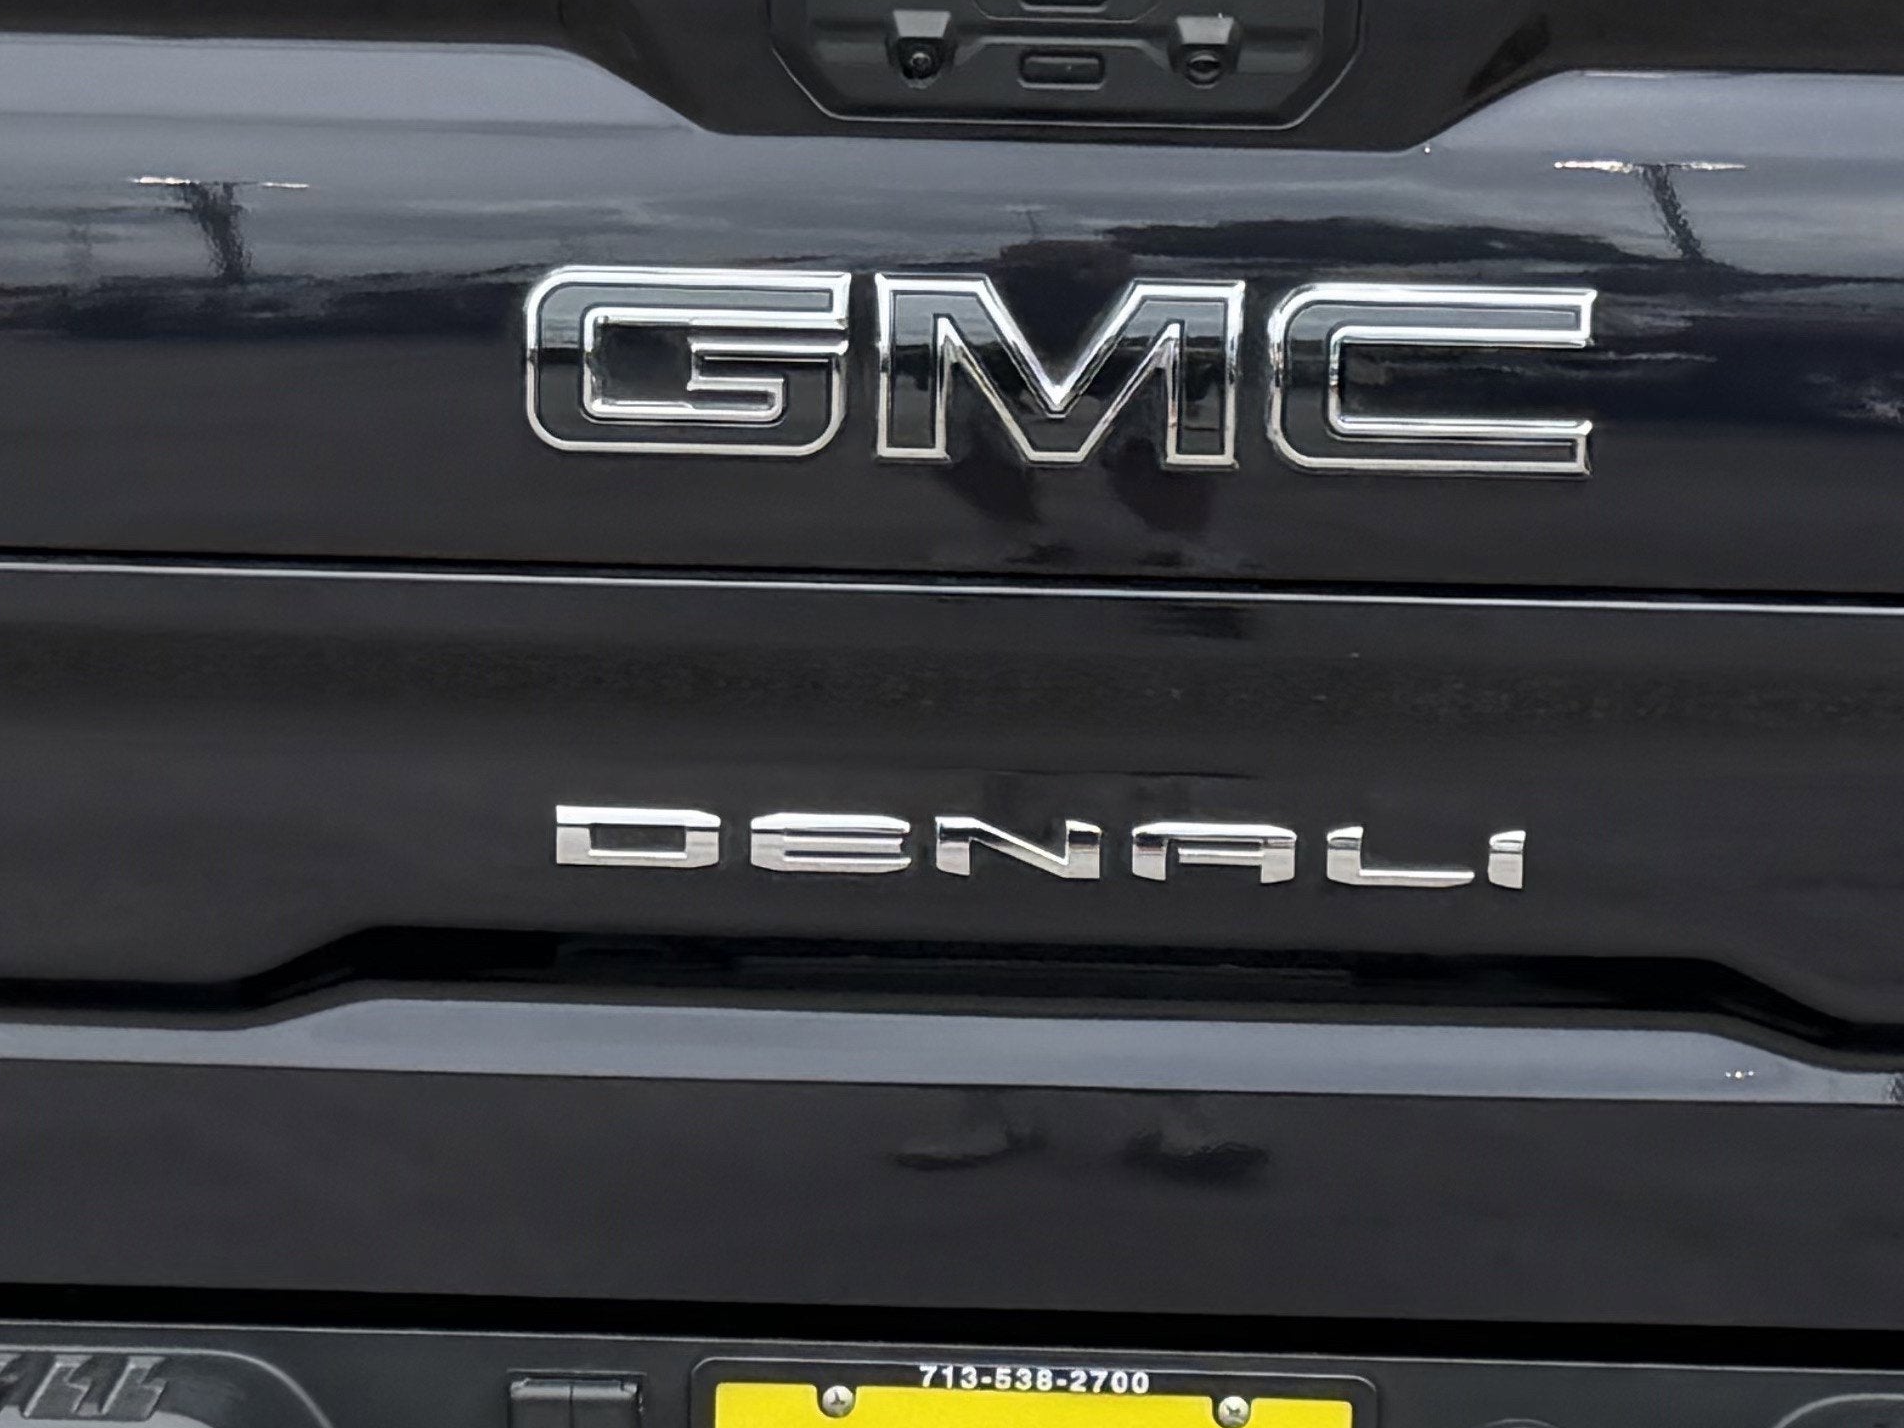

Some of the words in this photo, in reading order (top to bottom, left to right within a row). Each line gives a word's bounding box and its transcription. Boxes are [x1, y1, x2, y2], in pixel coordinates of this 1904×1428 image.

[524, 265, 1598, 476] GMC
[555, 803, 1527, 889] DENALI
[918, 1364, 1150, 1395] 713-538-2700
